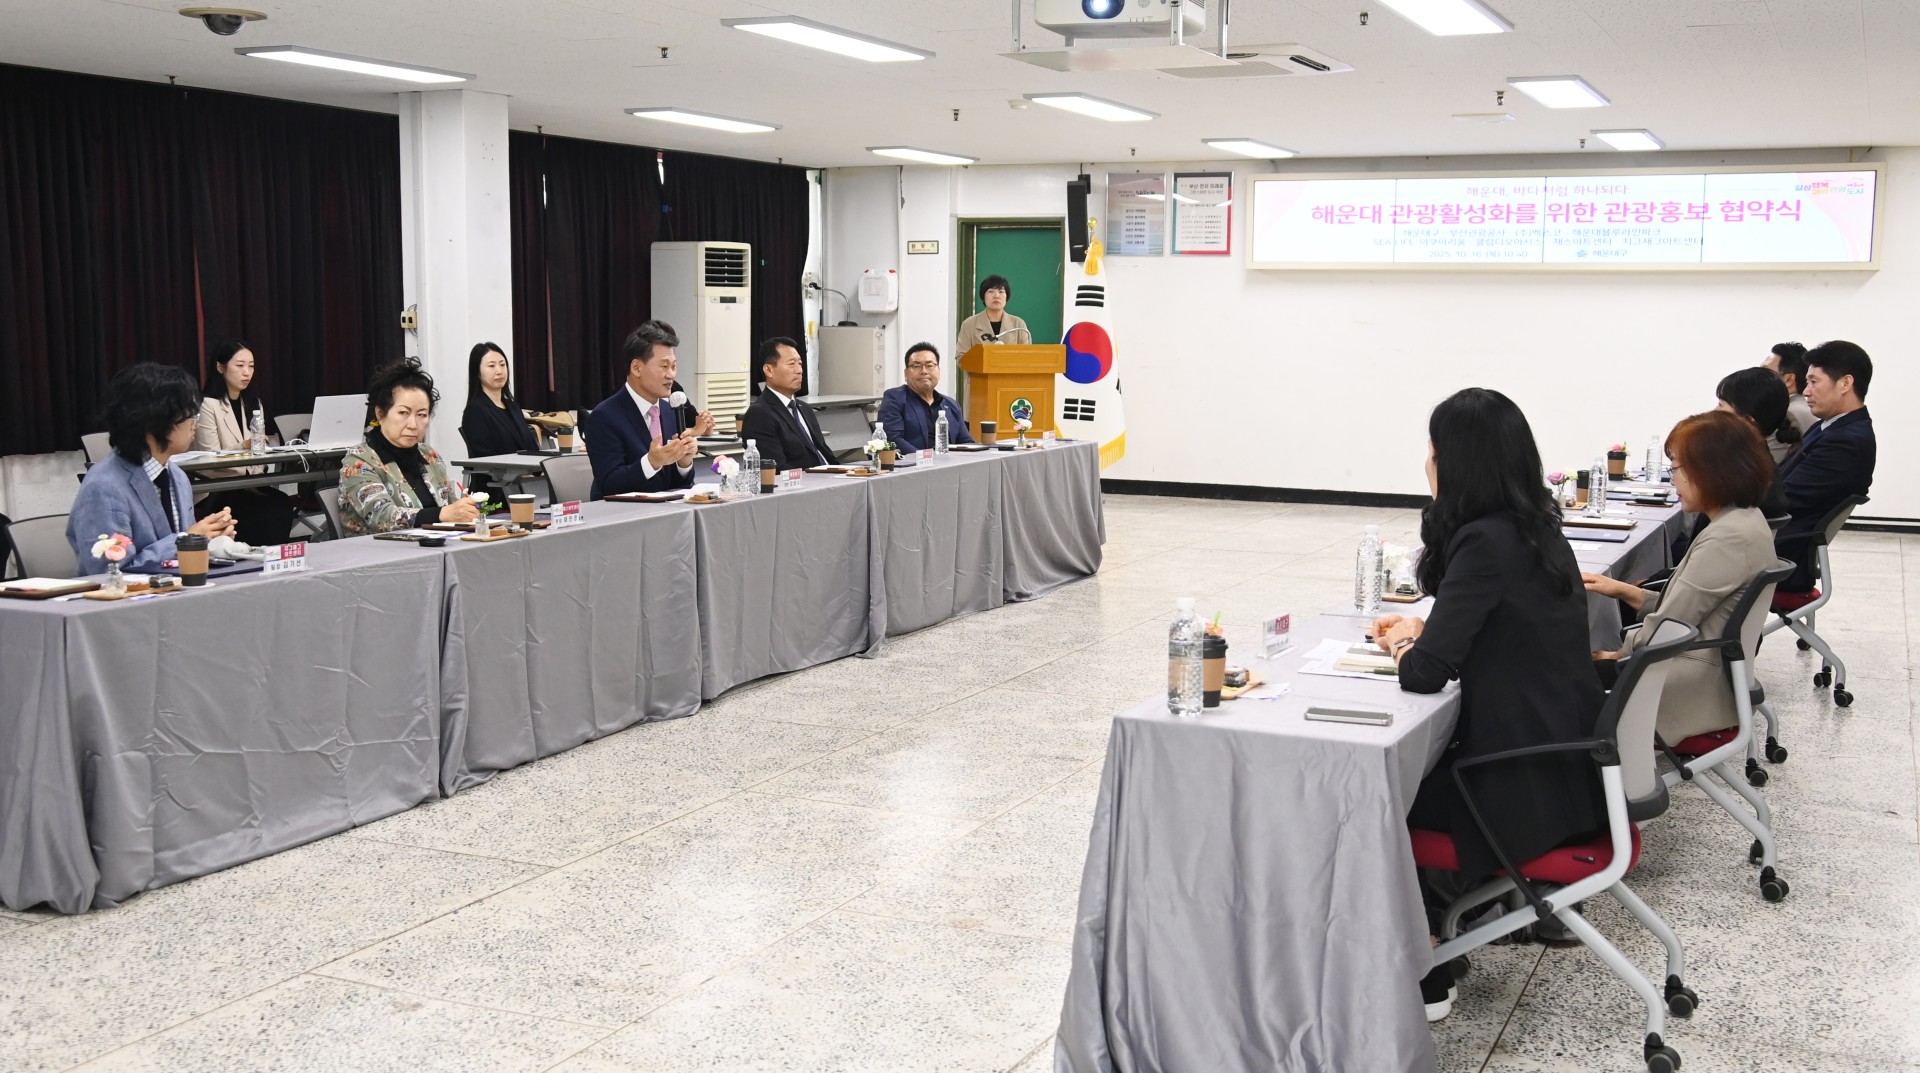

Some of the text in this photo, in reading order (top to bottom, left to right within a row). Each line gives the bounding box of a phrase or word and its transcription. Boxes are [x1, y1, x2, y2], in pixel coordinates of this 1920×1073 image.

[1573, 184, 1628, 196] 하나되다
[1311, 199, 1802, 225] 해운대 관광활성화를 위한 관광홍보 협약식
[1403, 229, 1439, 238] 해운대구
[1450, 229, 1504, 238] 부산관광공사
[1592, 249, 1628, 257] 해운대구
